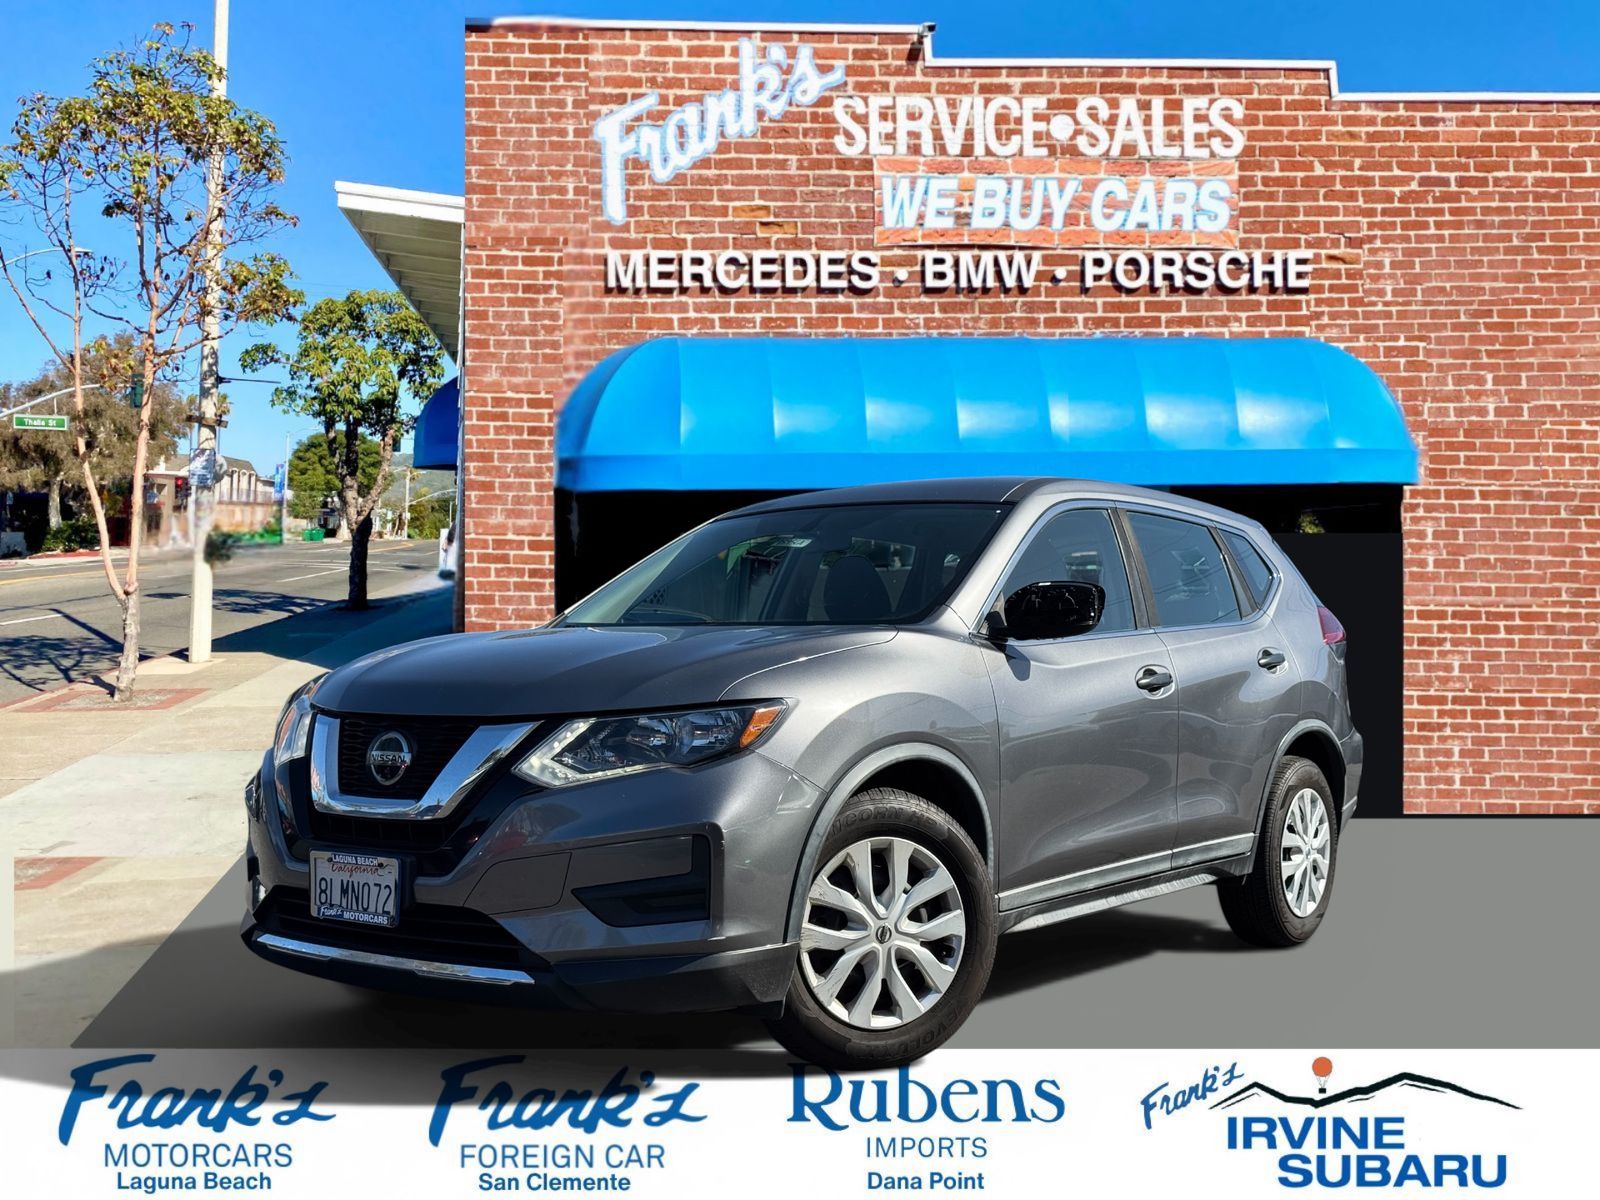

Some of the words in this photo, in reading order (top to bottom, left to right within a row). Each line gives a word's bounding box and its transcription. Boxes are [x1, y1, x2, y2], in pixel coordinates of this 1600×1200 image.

[593, 36, 846, 225] Frank's
[880, 175, 959, 230] WE
[970, 175, 1081, 231] BUY
[1090, 176, 1232, 232] CARS
[606, 251, 880, 289] MERCEDES
[924, 251, 1041, 289] BMW
[1083, 251, 1313, 289] PORSCHE
[331, 862, 384, 878] California
[332, 854, 357, 865] LAGUNA
[357, 856, 378, 866] BEACH
[343, 911, 388, 925] MOTORCARS
